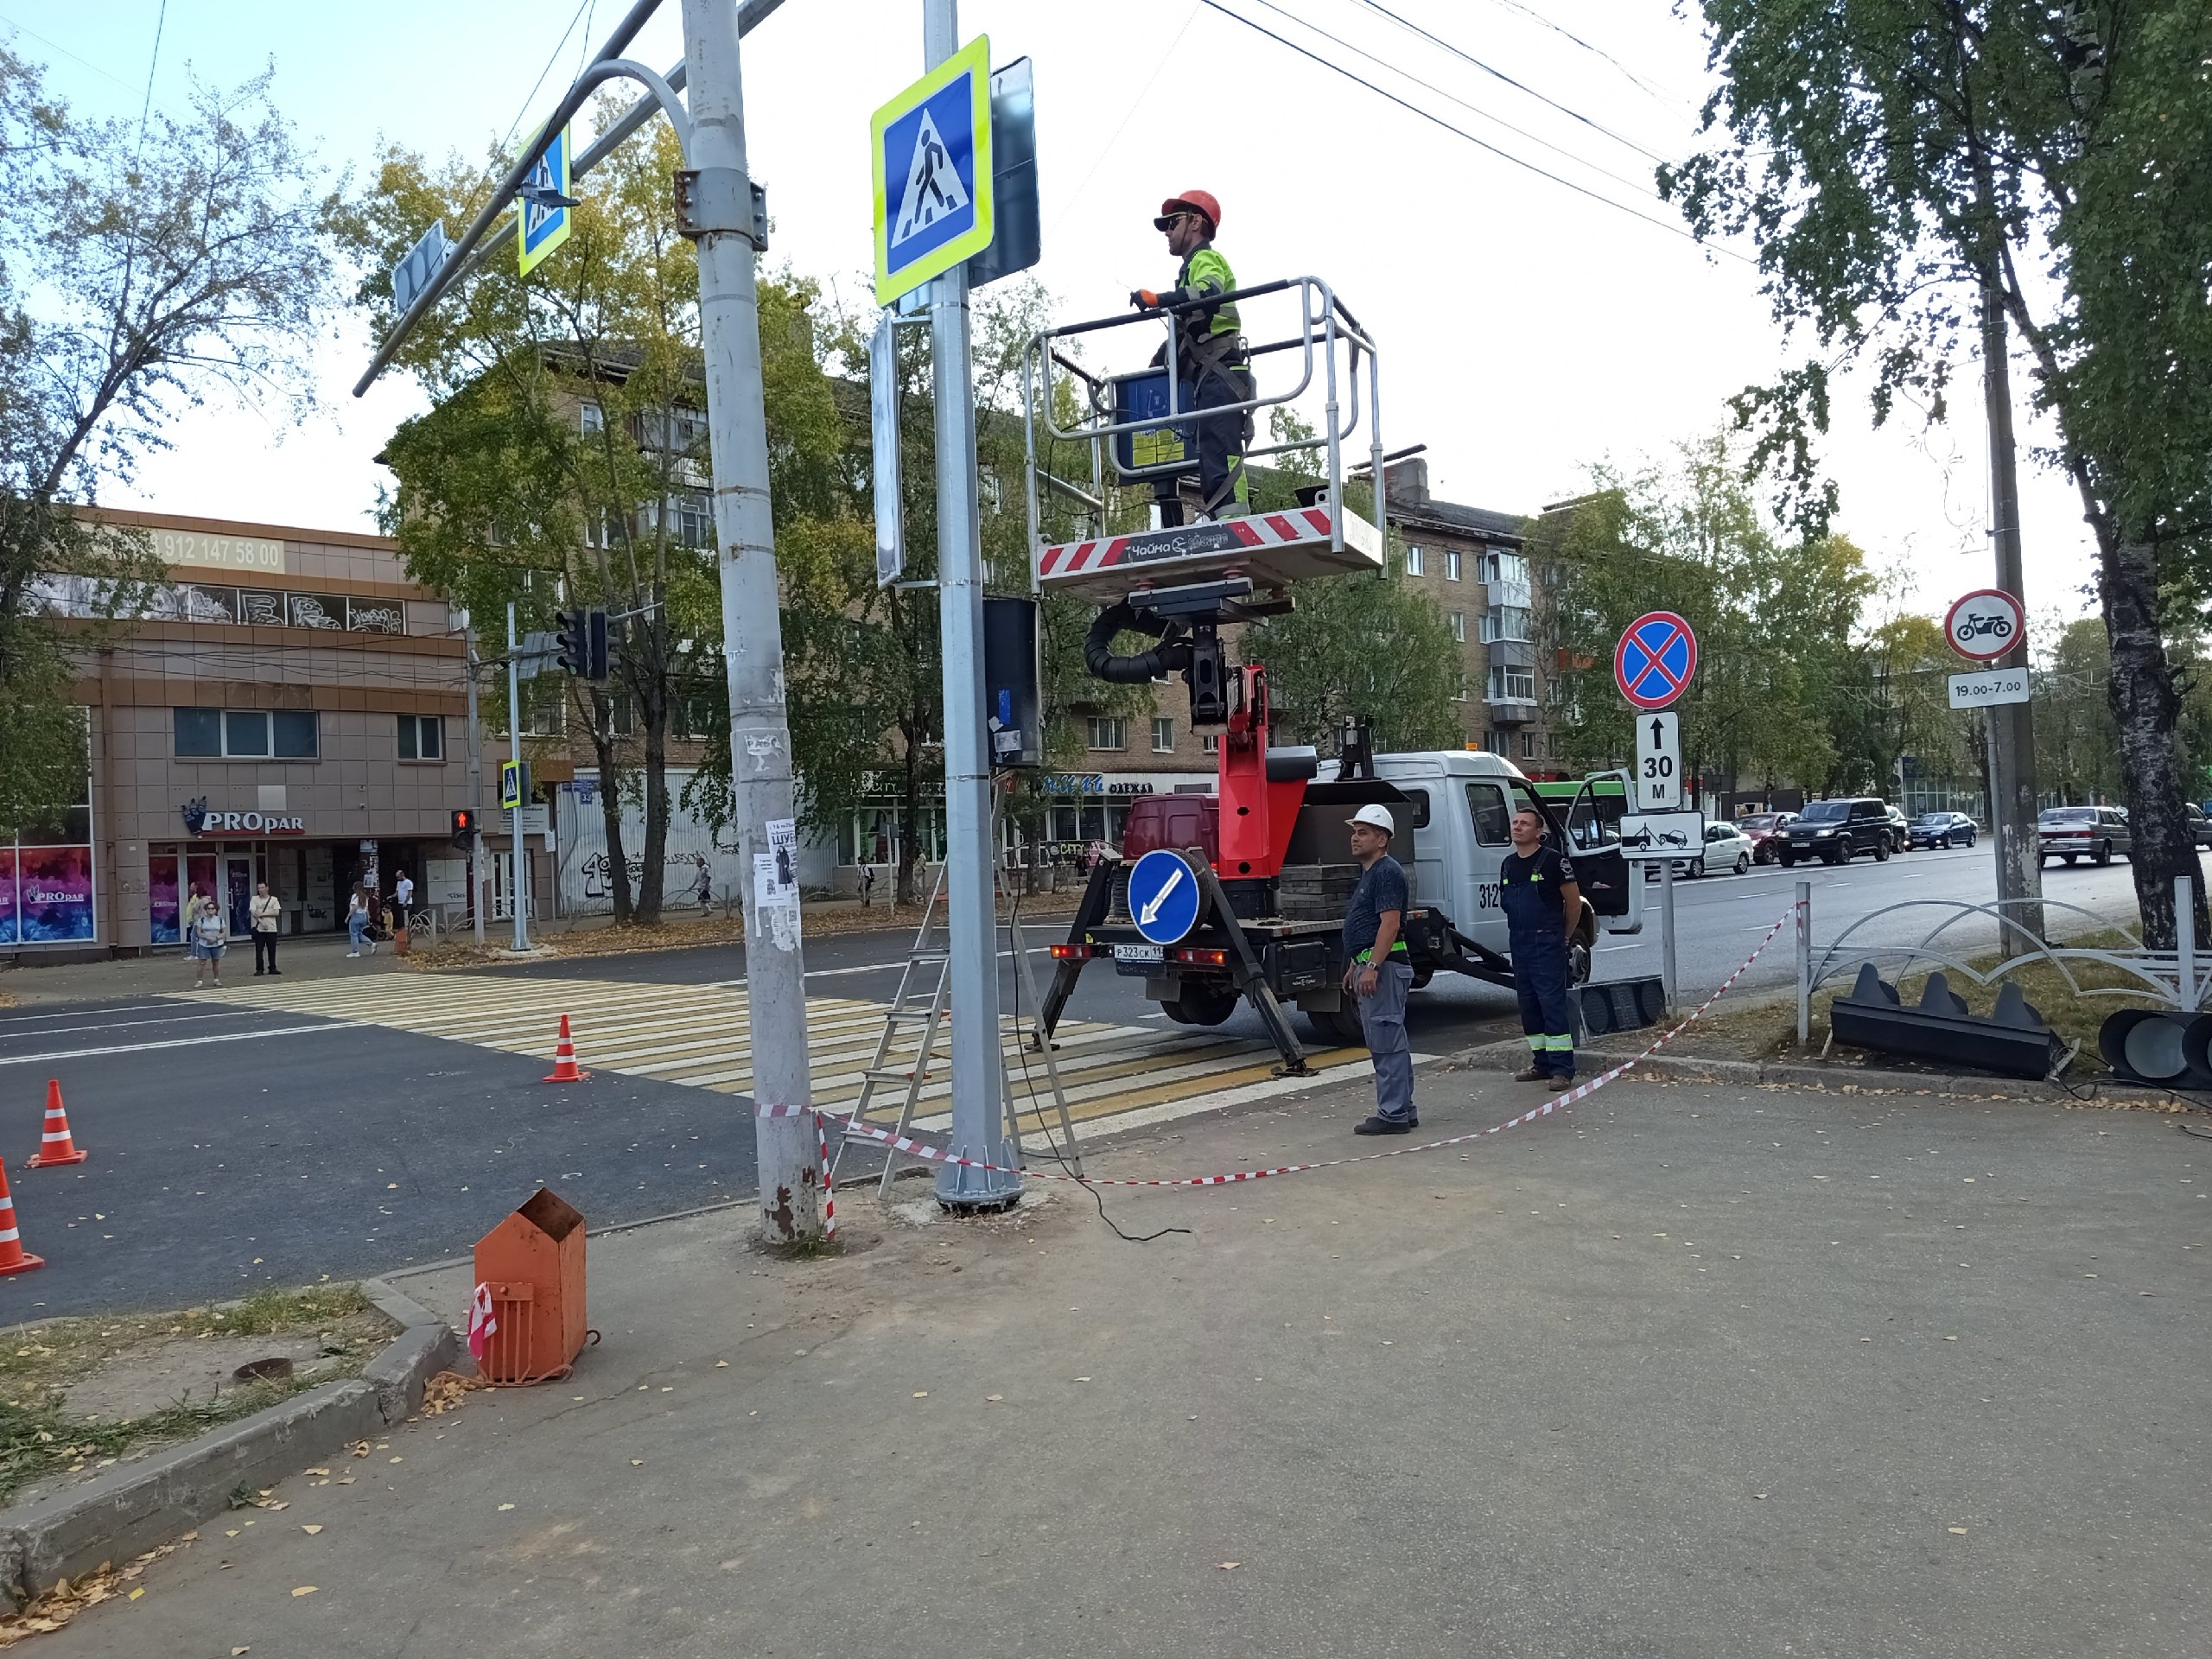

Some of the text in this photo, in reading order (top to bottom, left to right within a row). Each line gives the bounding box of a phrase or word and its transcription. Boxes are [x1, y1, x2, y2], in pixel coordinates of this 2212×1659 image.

[165, 535, 195, 559] 912
[201, 537, 231, 562] 147
[235, 542, 255, 564] 58
[259, 543, 278, 567] 00
[1955, 681, 2021, 697] 19.00-7.00
[1643, 755, 1673, 779] 30
[1060, 843, 1084, 855] CITY
